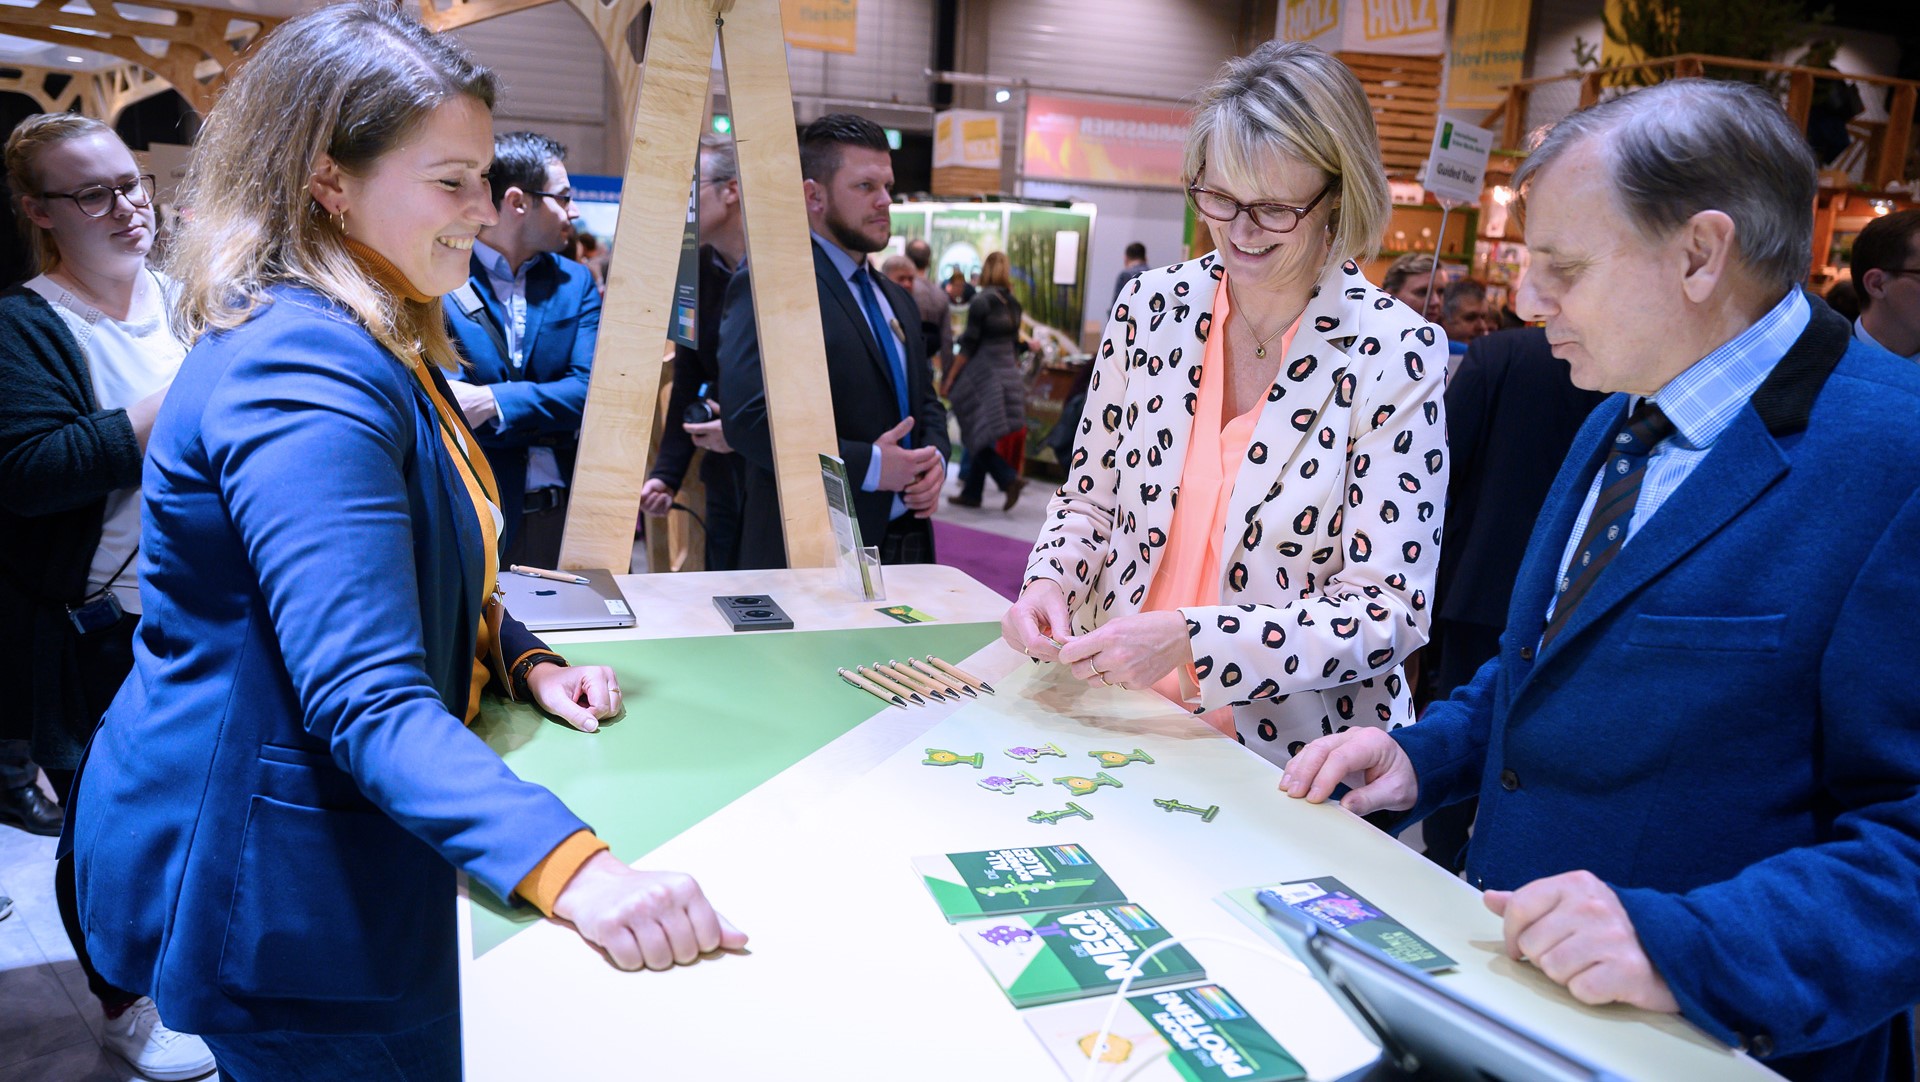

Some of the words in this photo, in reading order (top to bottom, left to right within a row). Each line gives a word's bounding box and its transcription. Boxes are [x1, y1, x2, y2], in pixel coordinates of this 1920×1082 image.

[1368, 0, 1434, 36] HOLZ
[1436, 162, 1461, 180] Guided
[1461, 169, 1477, 184] Tour
[1059, 910, 1145, 981] MEGA
[1153, 991, 1255, 1078] PROTEIN!
